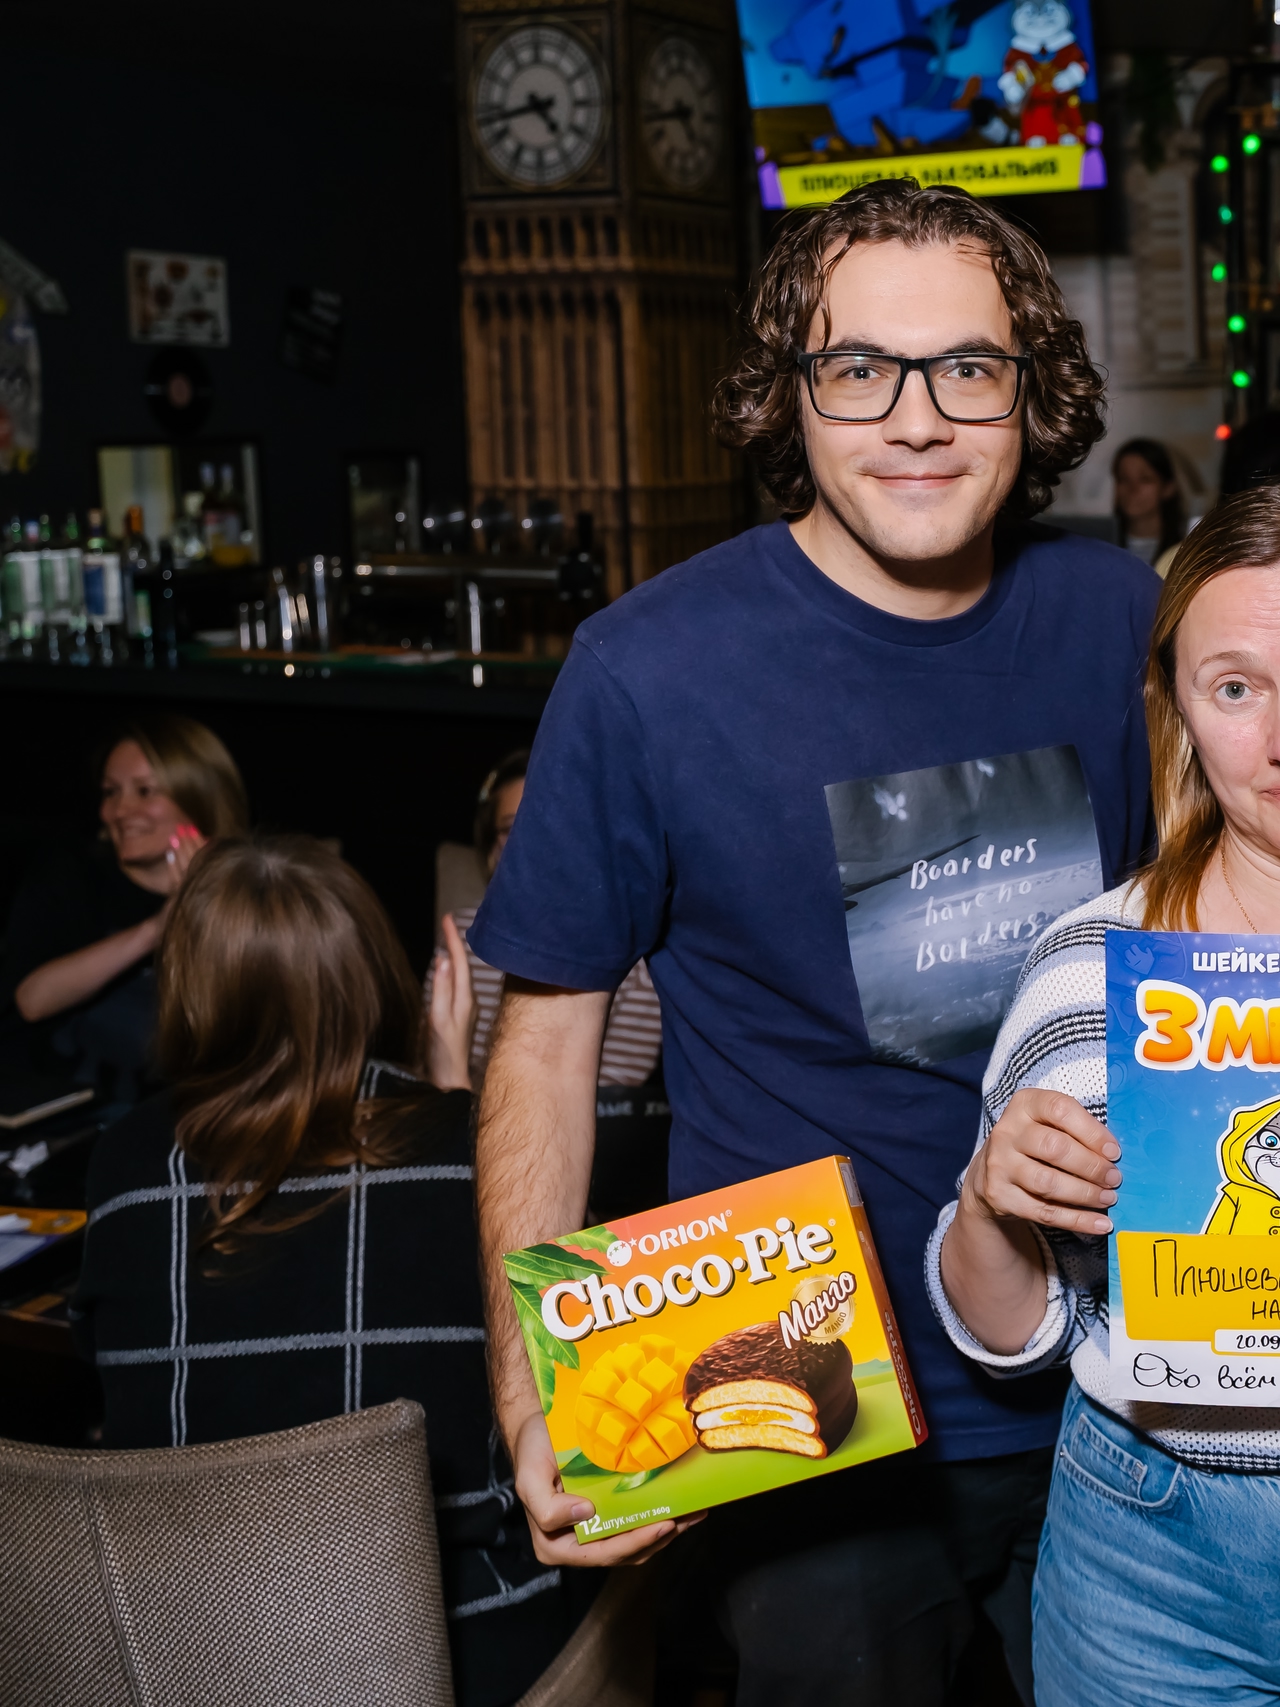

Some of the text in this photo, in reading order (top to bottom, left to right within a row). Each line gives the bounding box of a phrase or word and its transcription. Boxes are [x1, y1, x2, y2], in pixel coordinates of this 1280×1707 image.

[910, 838, 1037, 890] Boarders
[925, 879, 1033, 927] have no
[916, 914, 1038, 972] Borders
[1142, 989, 1198, 1063] 3
[638, 1213, 728, 1255] ORION
[779, 1271, 857, 1349] Манго
[824, 1311, 847, 1335] MANGO
[579, 1514, 604, 1536] 12
[625, 1513, 639, 1524] NET
[639, 1509, 651, 1520] WT
[651, 1506, 671, 1517] 360g
